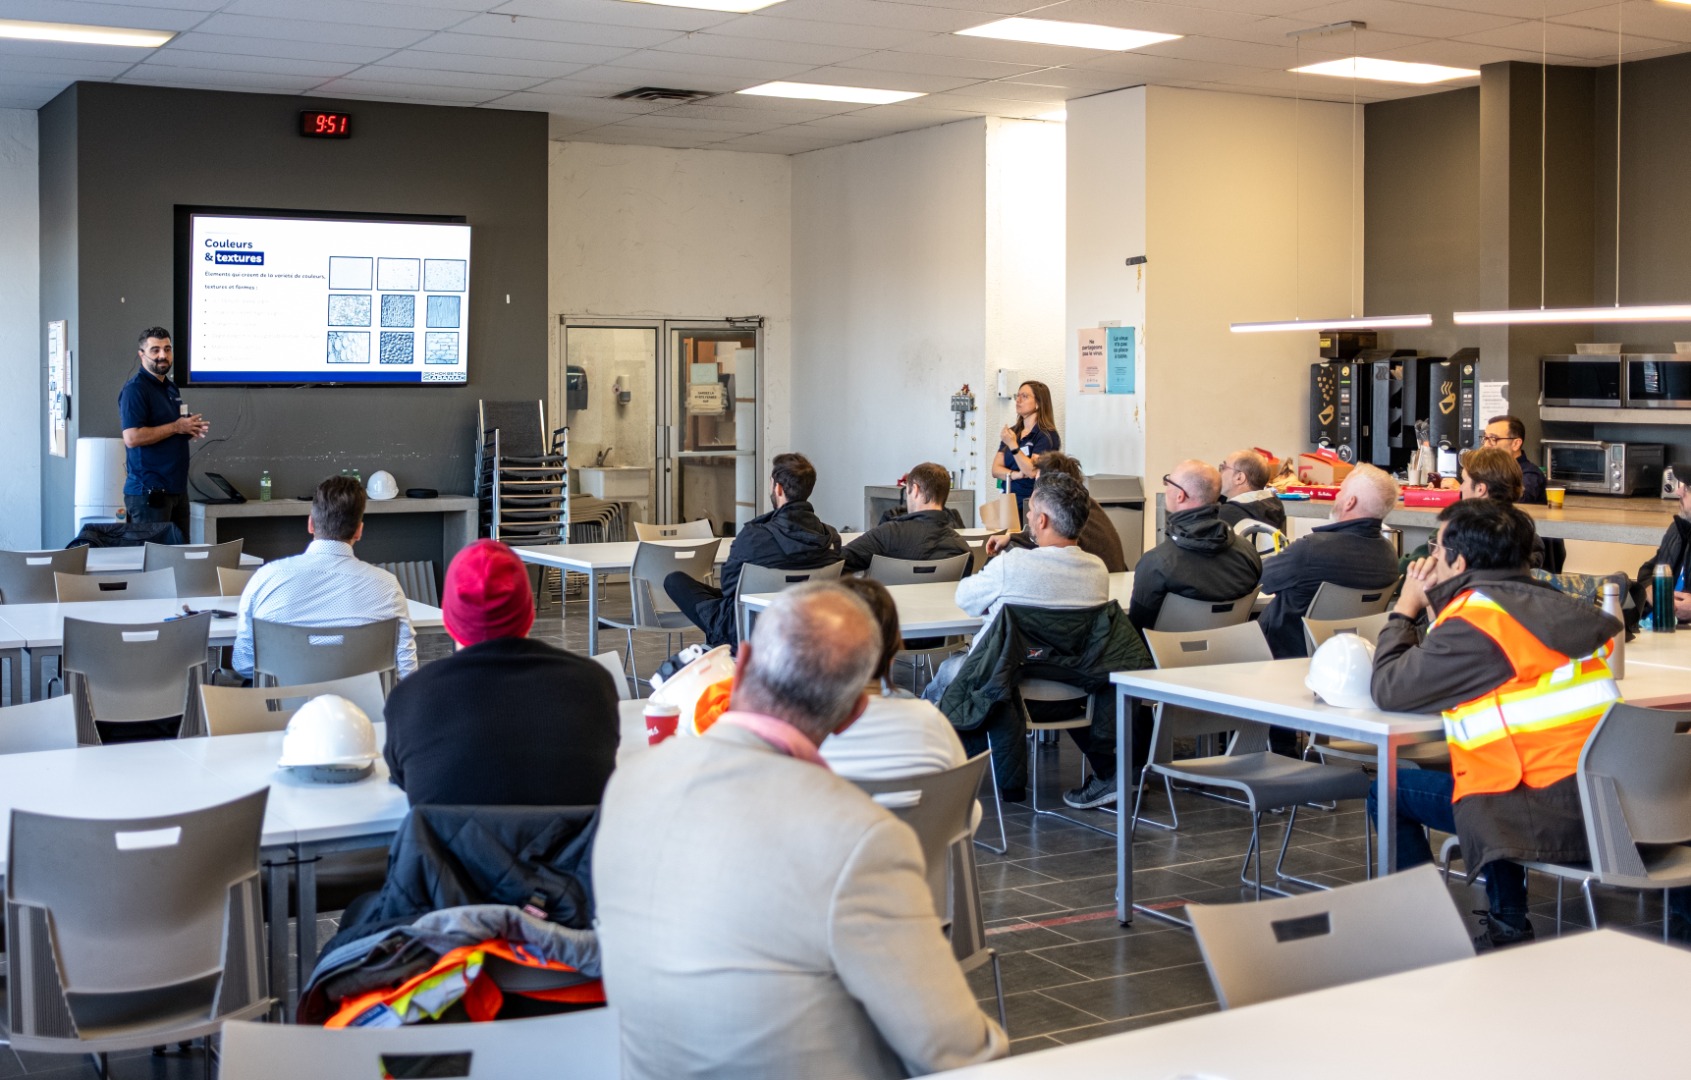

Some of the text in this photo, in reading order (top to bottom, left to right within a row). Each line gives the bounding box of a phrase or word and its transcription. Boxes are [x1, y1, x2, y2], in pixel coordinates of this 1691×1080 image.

[316, 115, 346, 133] 9:51
[204, 238, 253, 249] Couleurs
[204, 252, 262, 263] & textures
